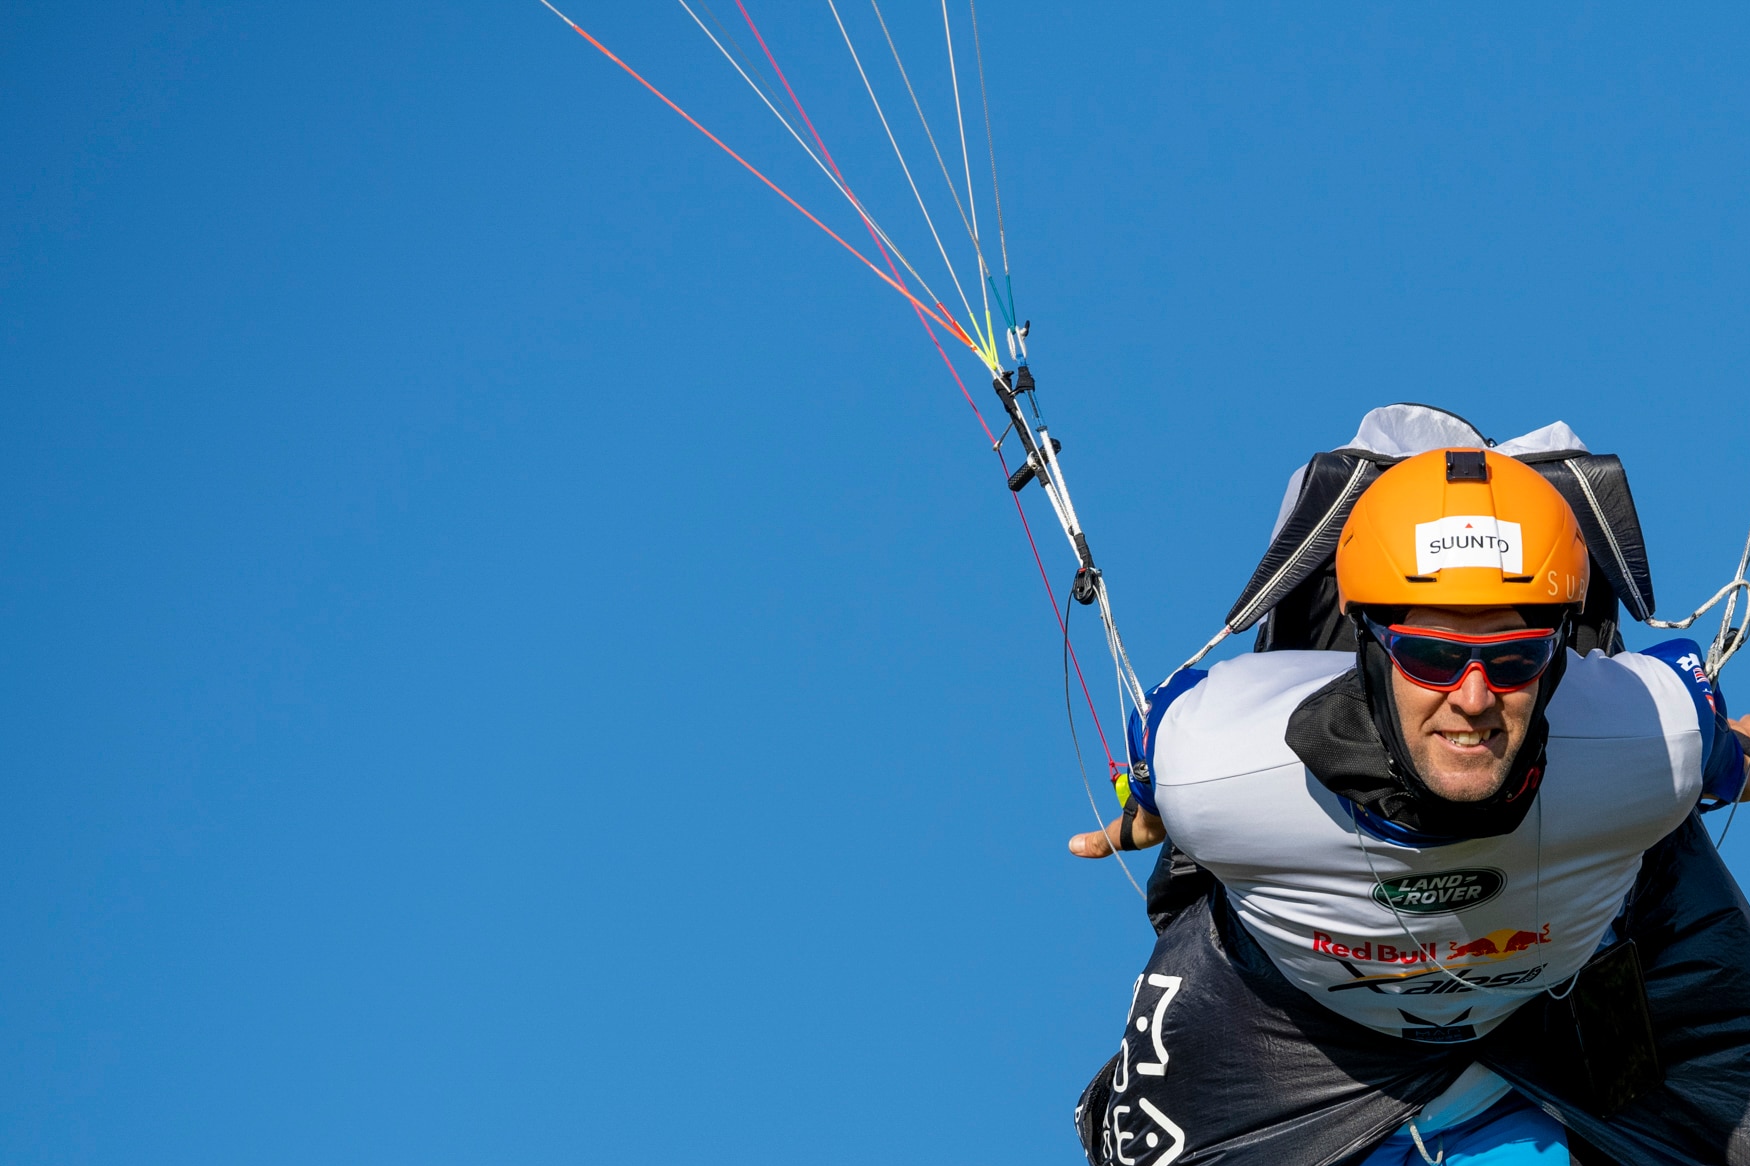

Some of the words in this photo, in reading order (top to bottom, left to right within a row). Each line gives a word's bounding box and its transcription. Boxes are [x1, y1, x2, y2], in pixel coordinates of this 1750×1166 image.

[1429, 535, 1510, 554] SUUNTO
[1399, 874, 1463, 891] LAND
[1403, 885, 1482, 905] ROVER
[1313, 930, 1371, 961] Red
[1378, 942, 1436, 964] Bull
